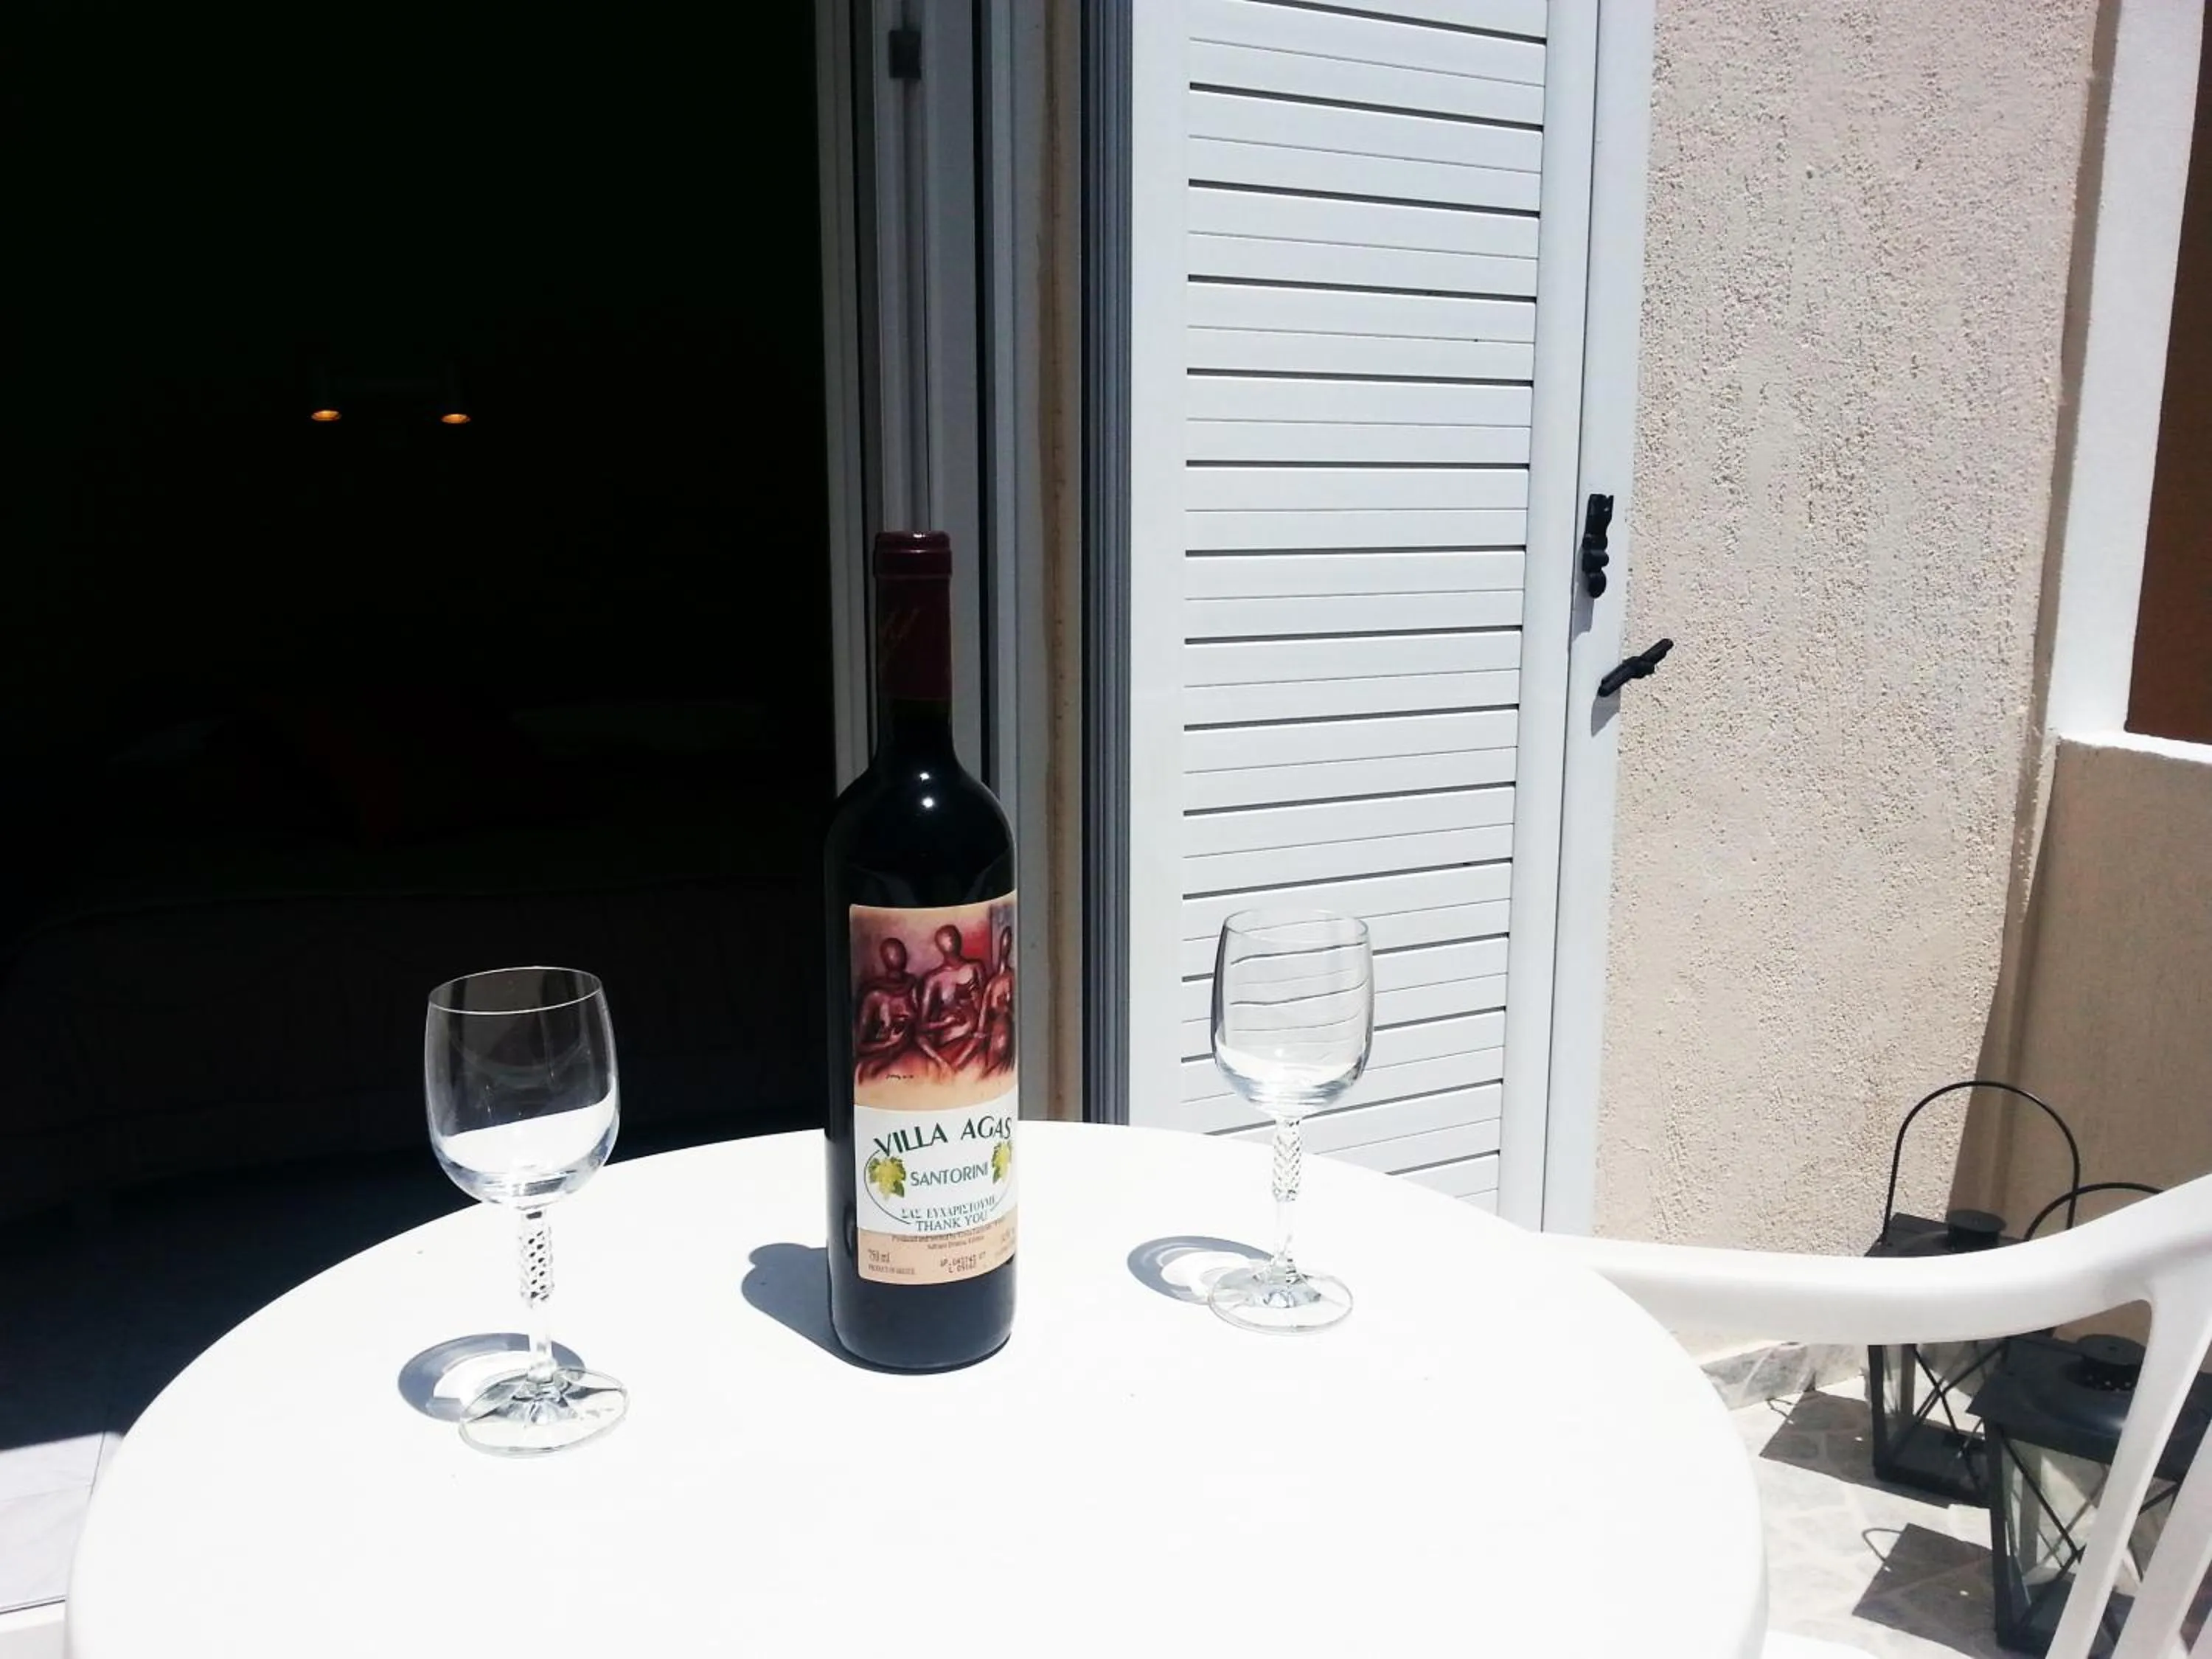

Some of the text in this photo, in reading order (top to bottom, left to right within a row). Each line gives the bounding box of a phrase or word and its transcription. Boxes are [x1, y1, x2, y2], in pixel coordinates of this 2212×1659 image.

[873, 1116, 1012, 1157] VILLA AGAS
[911, 1162, 989, 1186] SANTORINI
[915, 1217, 961, 1232] THANK
